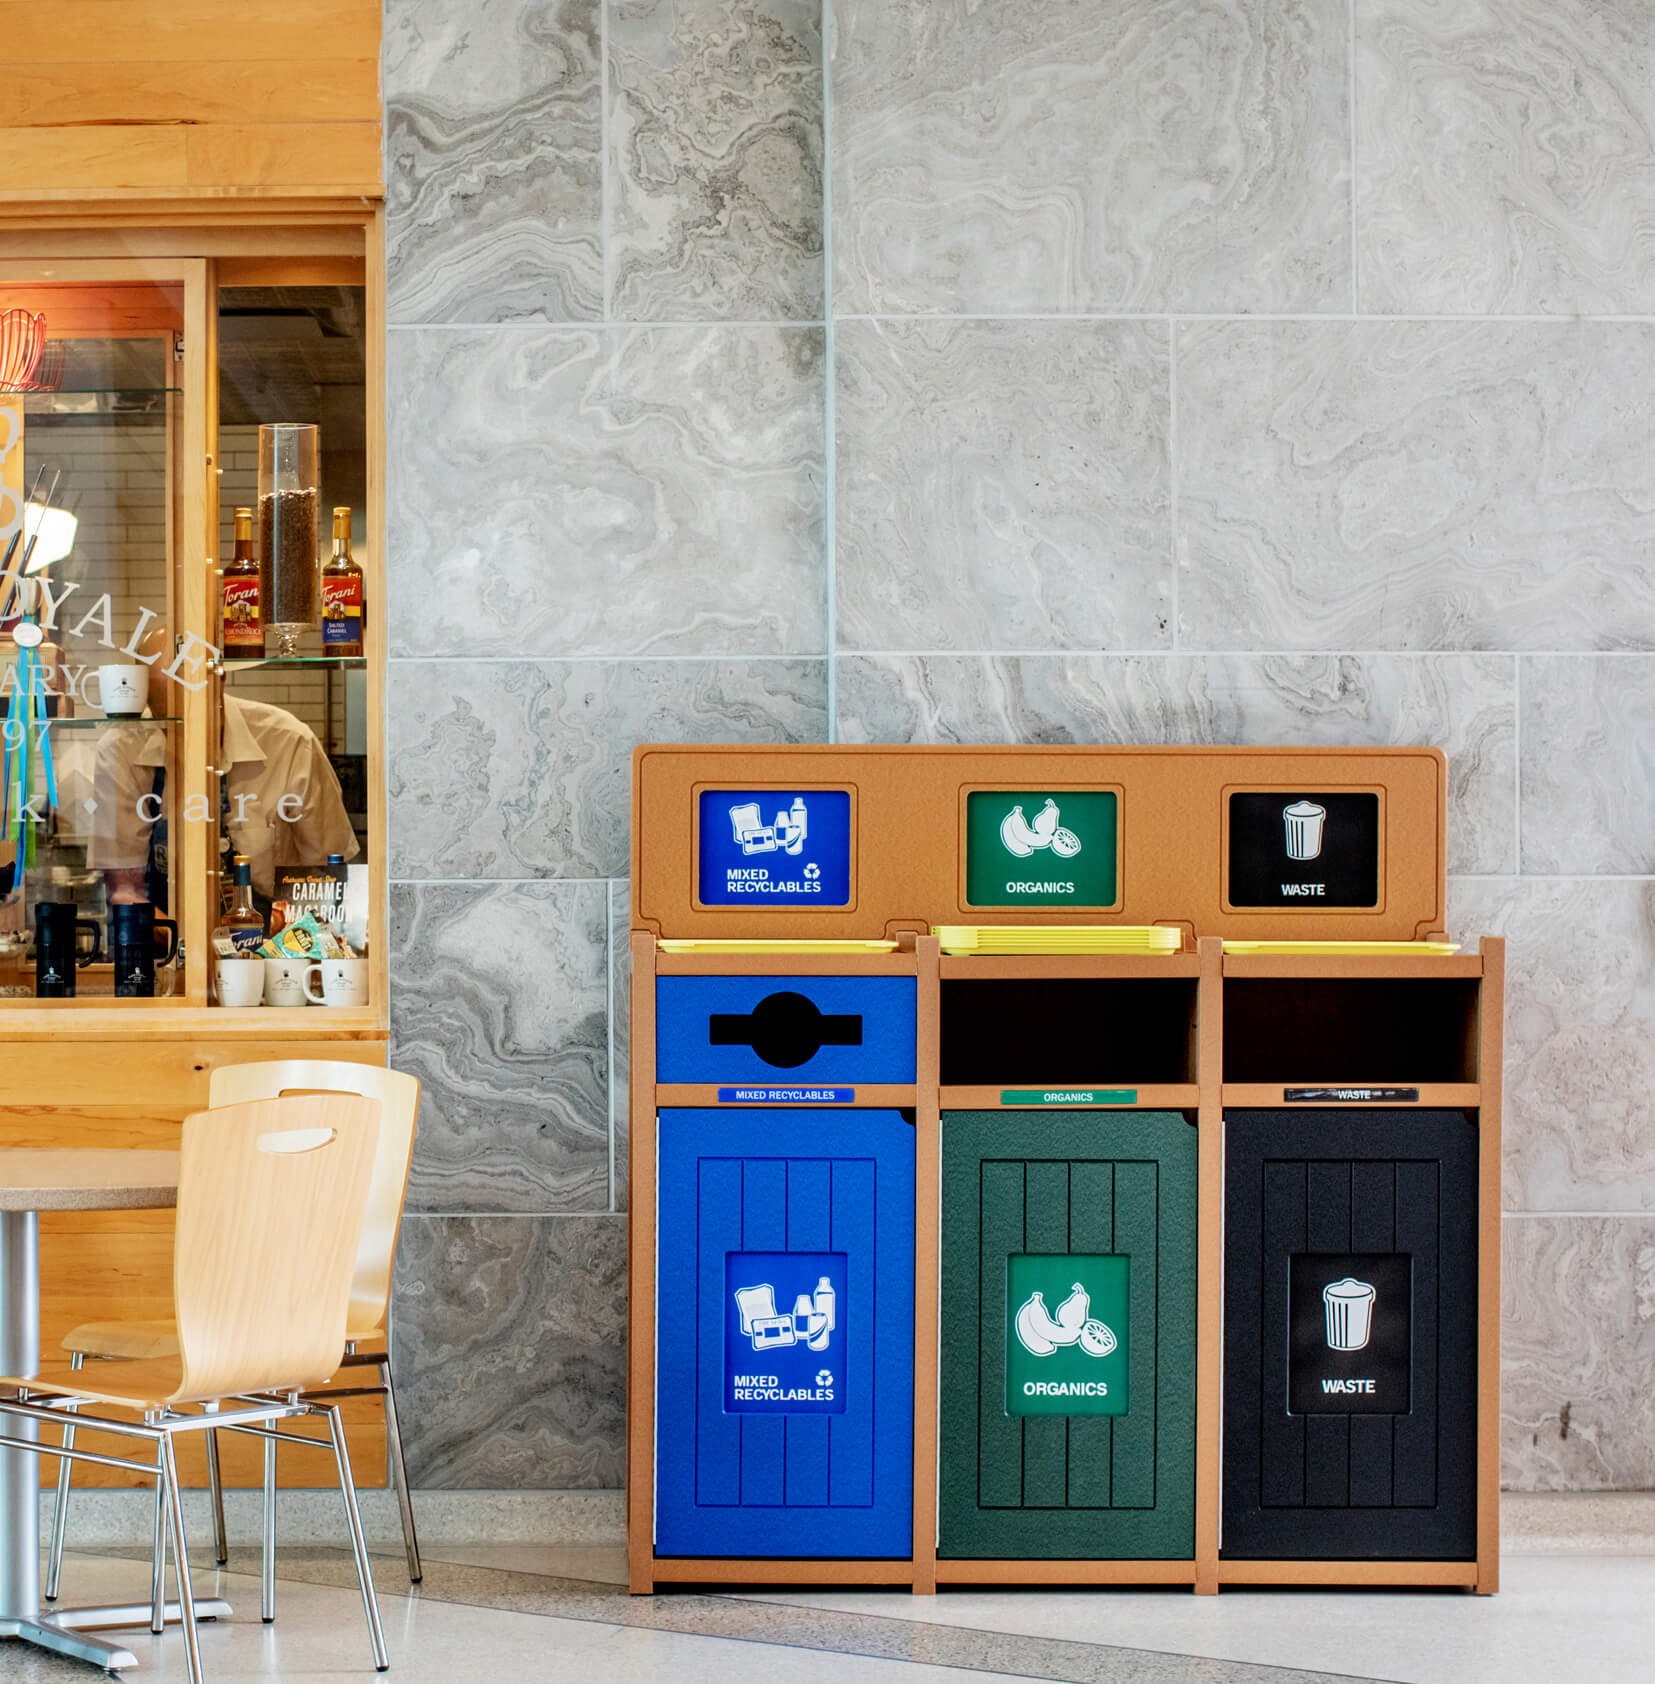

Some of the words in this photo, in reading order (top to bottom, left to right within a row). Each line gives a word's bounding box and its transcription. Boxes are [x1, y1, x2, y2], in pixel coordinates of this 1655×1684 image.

[223, 583, 259, 608] Toran
[322, 583, 357, 608] Torani
[2, 719, 52, 752] 97
[136, 792, 304, 823] care
[727, 869, 769, 880] MIXED
[727, 881, 822, 893] RECYCLABLES
[1006, 881, 1075, 894] ORGANICS
[1281, 884, 1326, 896] WASTE
[285, 904, 353, 923] MACROO
[229, 931, 264, 950] rani
[735, 1091, 766, 1101] MIXED
[768, 1091, 836, 1101] RECYCLABLES
[1043, 1092, 1094, 1102] ORGANICS
[1337, 1089, 1371, 1100] WASTE
[734, 1375, 779, 1387] MIXED
[1321, 1379, 1377, 1394] WASTE
[734, 1388, 835, 1401] RECYCLABLES
[1023, 1381, 1108, 1396] ORGANICS
